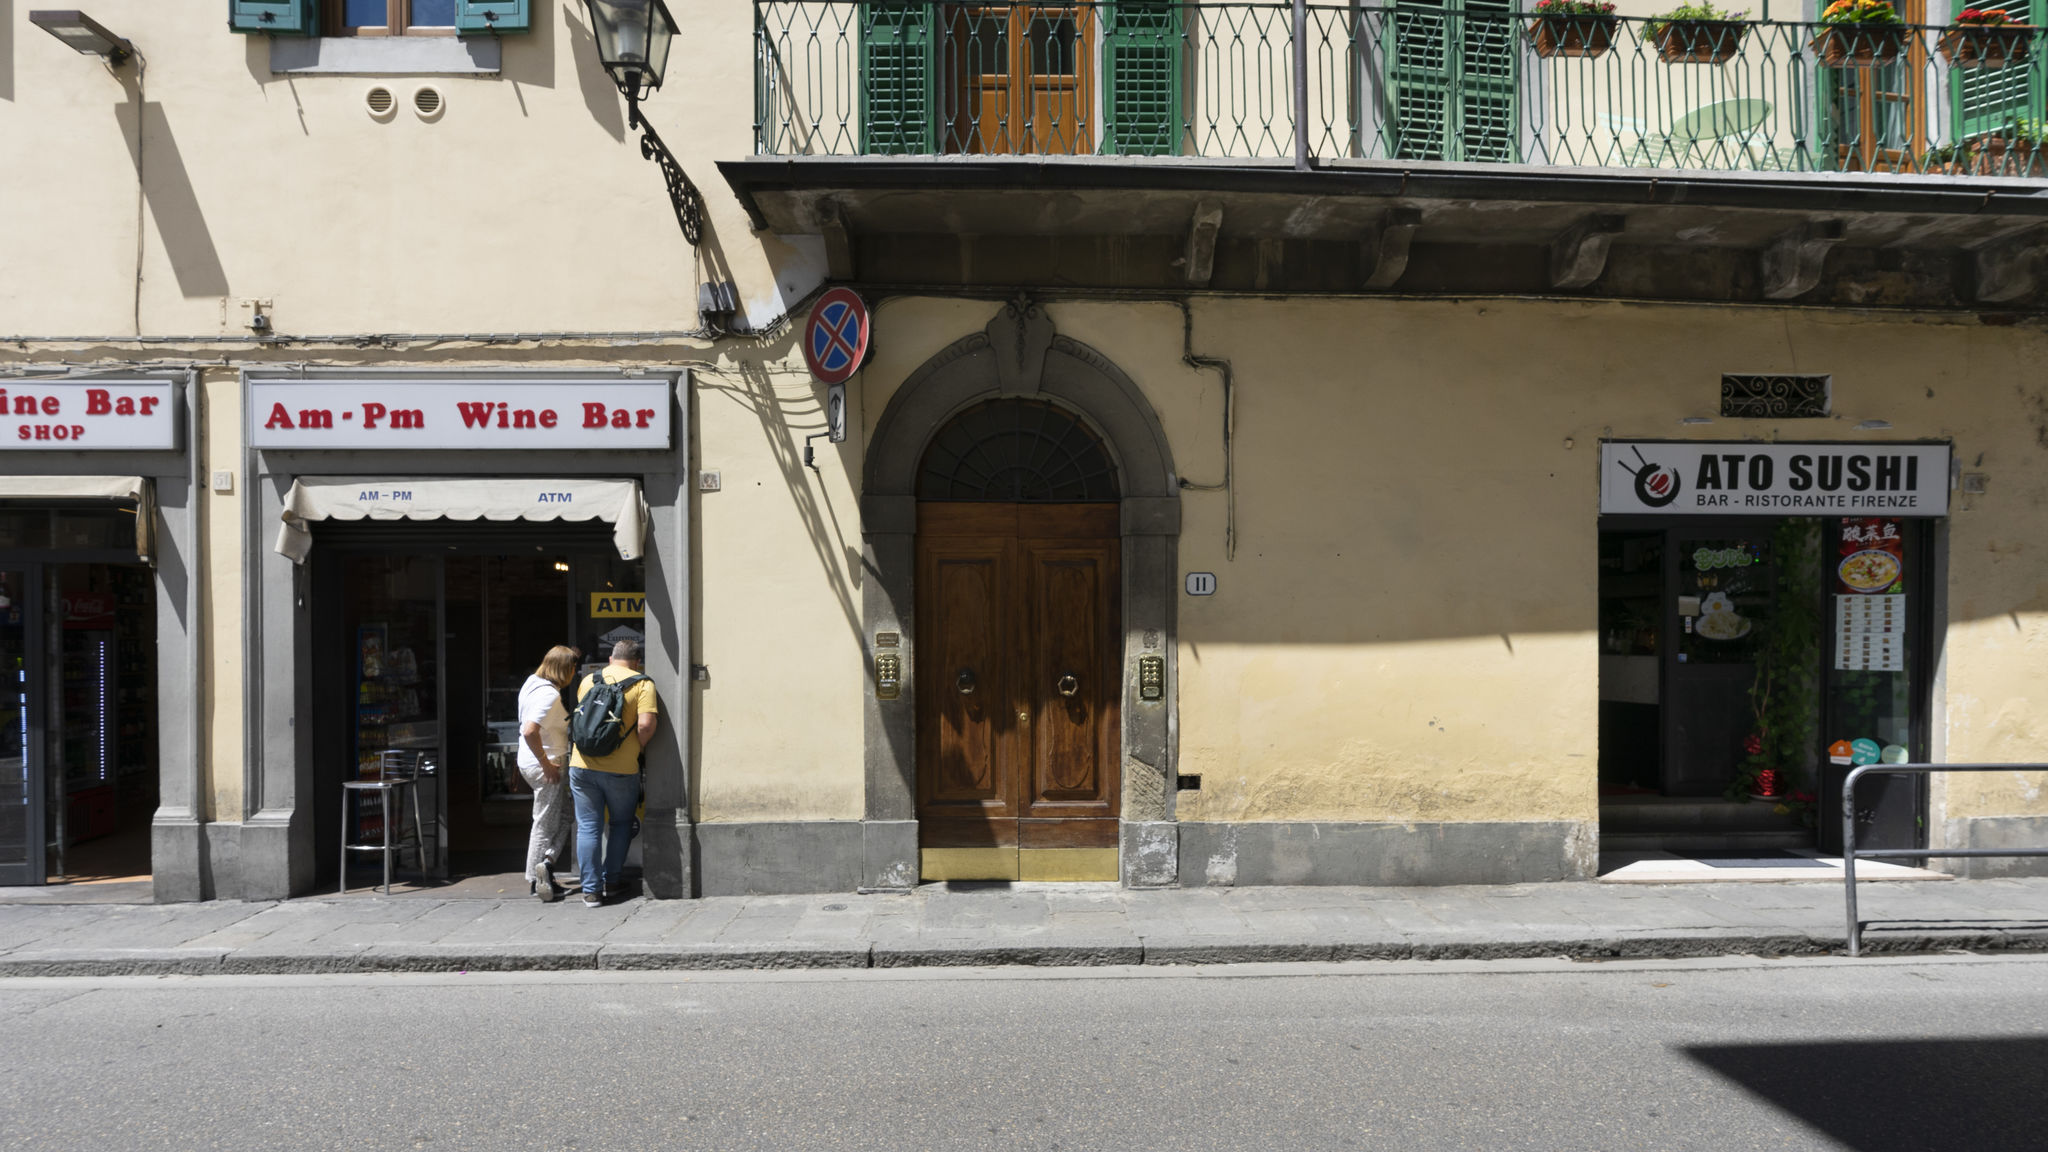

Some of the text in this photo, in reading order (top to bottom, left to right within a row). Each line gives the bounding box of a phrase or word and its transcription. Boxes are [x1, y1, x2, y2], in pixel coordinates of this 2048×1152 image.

[0, 388, 160, 416] ine Bar
[457, 402, 558, 429] Wine
[582, 402, 655, 429] Bar
[18, 424, 85, 440] SHOP
[1695, 454, 1918, 492] ATO SUSHI
[537, 492, 573, 503] ATM
[1696, 494, 1729, 507] BAR
[1745, 495, 1846, 507] RISTORANTE
[1851, 495, 1918, 508] FIRENZE
[1196, 576, 1206, 592] 11
[597, 598, 646, 612] ATM
